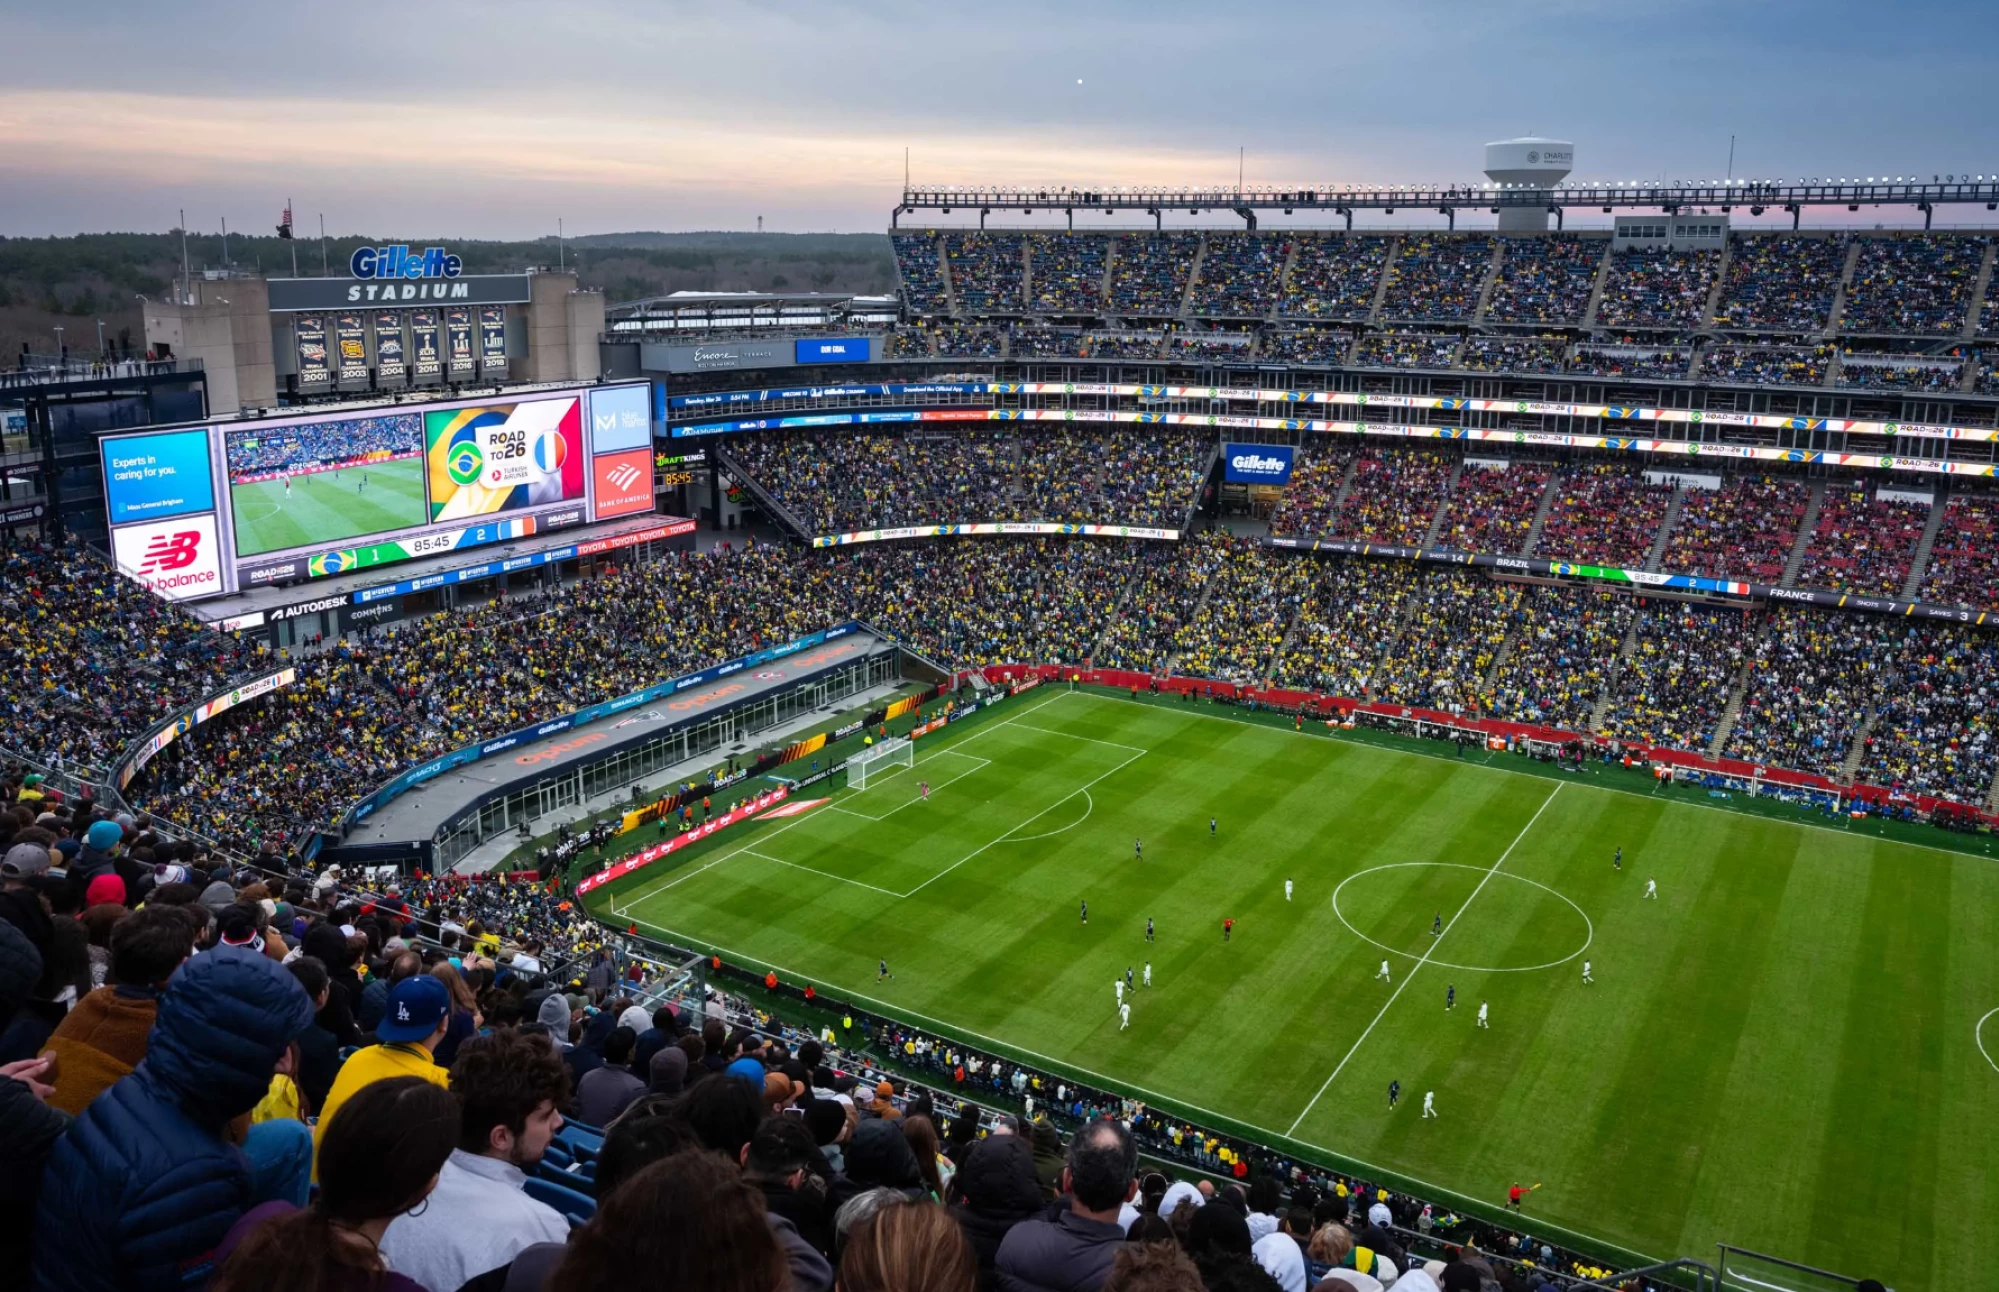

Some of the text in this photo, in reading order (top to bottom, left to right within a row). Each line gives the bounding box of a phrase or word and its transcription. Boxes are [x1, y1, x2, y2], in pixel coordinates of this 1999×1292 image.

[351, 245, 462, 280] Gillette
[348, 283, 469, 301] STADIUM
[694, 347, 738, 362] Encore
[342, 370, 367, 378] 2003
[380, 367, 404, 376] 2004
[418, 365, 439, 373] 2014
[303, 373, 328, 382] 2001
[490, 430, 526, 445] ROAD
[700, 427, 724, 435] Mutual
[113, 455, 156, 468] Experts in
[490, 450, 504, 461] TO
[656, 454, 705, 466] DRAFTKINGS
[1232, 455, 1285, 471] Gillette
[114, 467, 177, 480] caring for you.
[504, 472, 528, 480] AIRLINES
[666, 472, 691, 485] 85:45
[162, 498, 184, 507] Brigham
[599, 500, 615, 508] BANK
[625, 494, 650, 503] AMERICA
[477, 529, 486, 541] 2
[669, 523, 695, 535] TOYOTA
[611, 536, 638, 548] TOYOTA
[640, 530, 666, 543] TOYOTA
[414, 536, 450, 552] 85:45
[578, 542, 607, 554] TOYOTA
[372, 549, 380, 562] 1
[1452, 554, 1464, 562] 14
[1496, 558, 1529, 569] BRAZIL
[251, 568, 277, 580] ROAD
[1599, 569, 1604, 577] 1
[1634, 573, 1659, 583] 85:45
[157, 570, 215, 591] balance
[1689, 578, 1696, 587] 2
[1769, 588, 1815, 601] FRANCE
[286, 596, 348, 618] AUTODESK
[1888, 602, 1896, 611] 7
[1929, 609, 1969, 621] SAVES 3
[826, 628, 846, 639] Gillette
[718, 662, 742, 675] Gillette
[677, 676, 702, 689] Gillette
[668, 684, 746, 710] Optum
[538, 720, 569, 735] Gillette
[483, 738, 516, 753] Gillette
[515, 732, 608, 765] Optum
[714, 774, 734, 789] ROAD
[802, 773, 826, 788] UNIVERSAL
[556, 839, 574, 857] ROAD
[397, 1001, 410, 1021] LA
